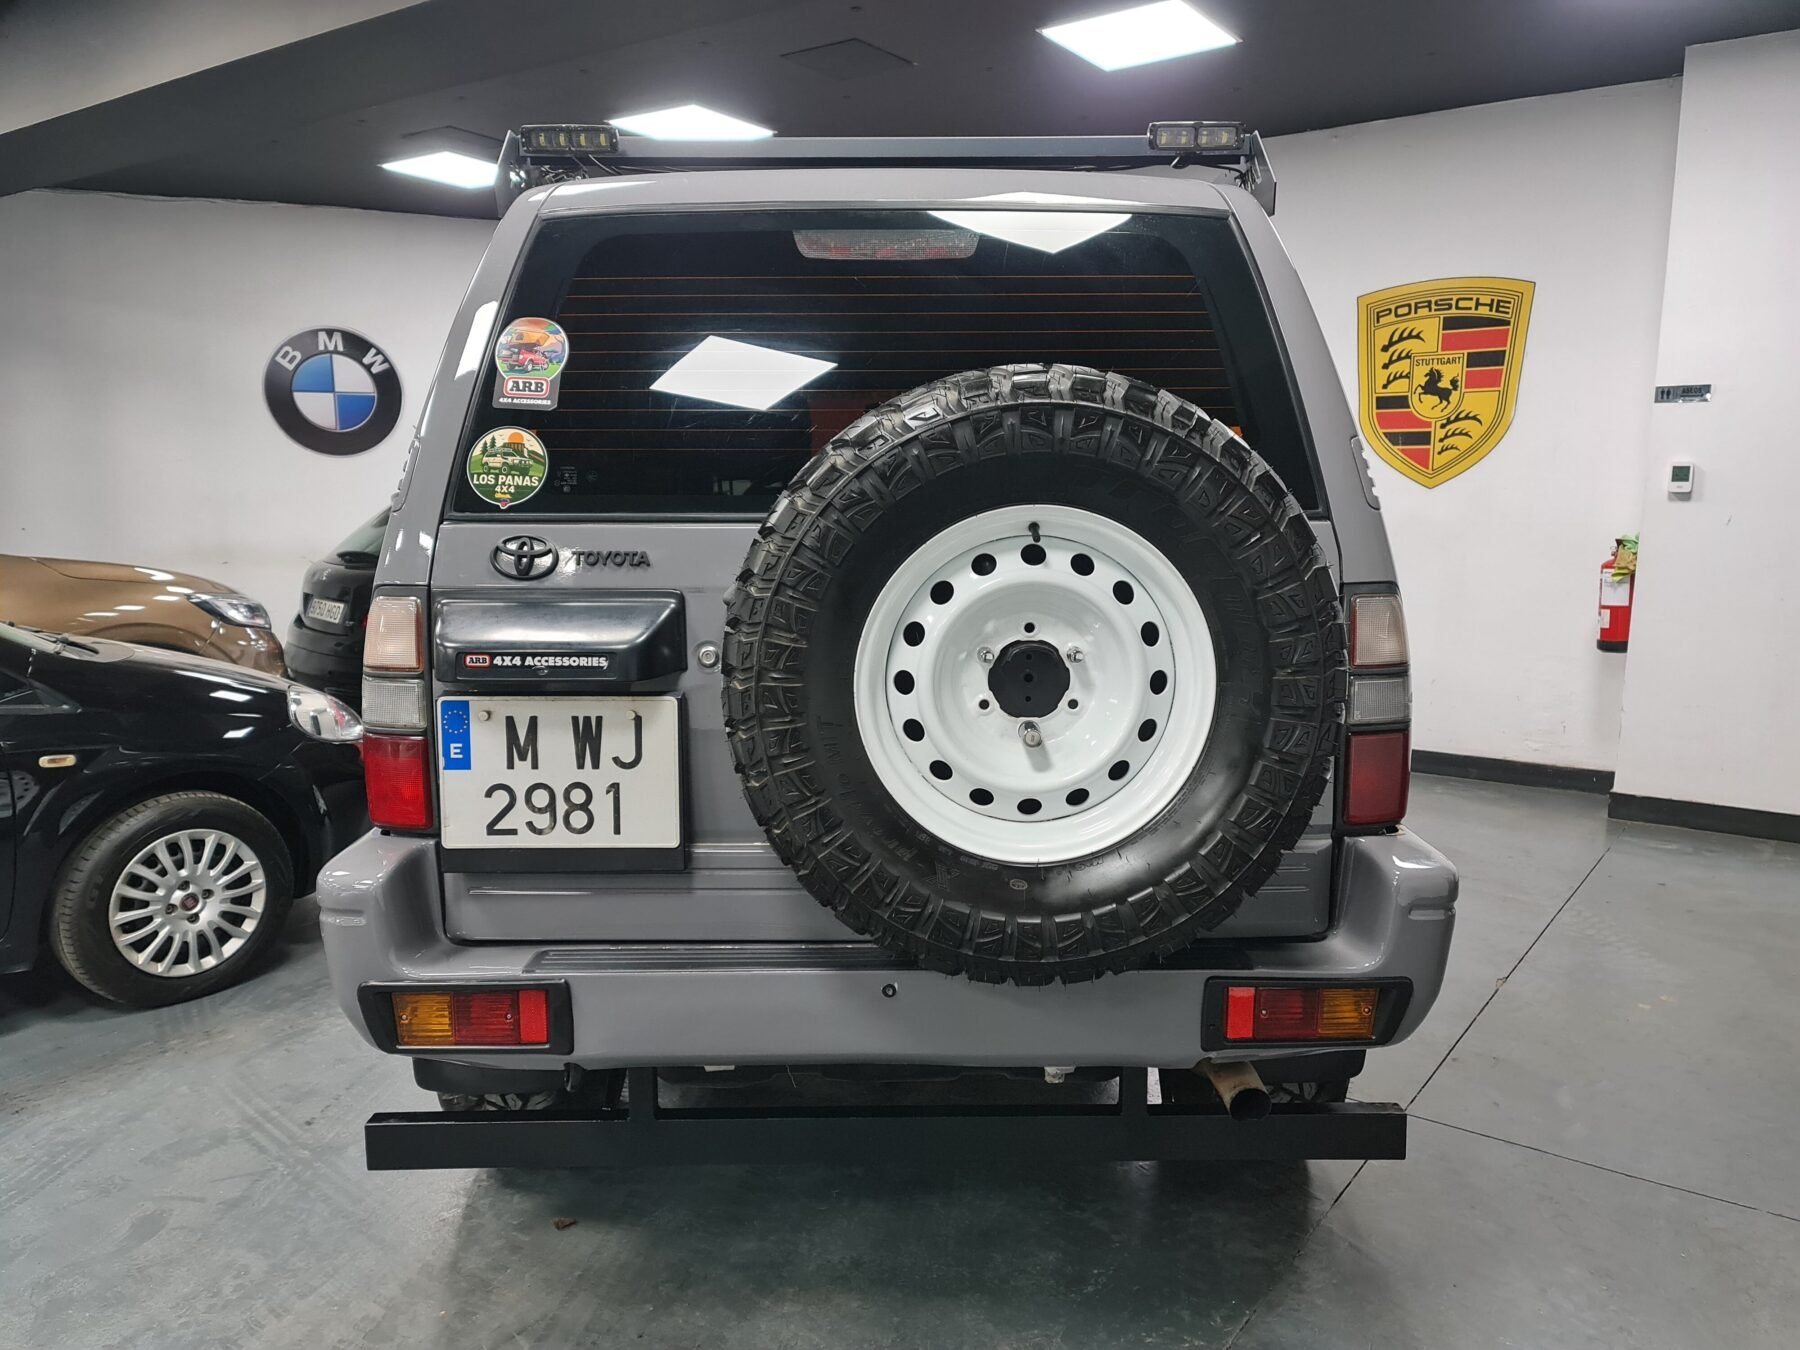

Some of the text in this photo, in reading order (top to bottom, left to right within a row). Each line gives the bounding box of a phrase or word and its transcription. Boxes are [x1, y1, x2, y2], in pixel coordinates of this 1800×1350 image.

[1376, 297, 1512, 324] PORSCHE
[275, 331, 390, 375] BMW
[1415, 356, 1463, 367] STUTTGART
[509, 380, 545, 393] ARB
[473, 474, 539, 487] LOS PANAS
[494, 485, 515, 493] 4X4
[571, 550, 651, 567] TOYOTA
[468, 656, 607, 668] ARB 4X4 ACCESSORIES
[505, 715, 643, 770] M WJ
[450, 743, 464, 758] E
[484, 781, 622, 836] 2981
